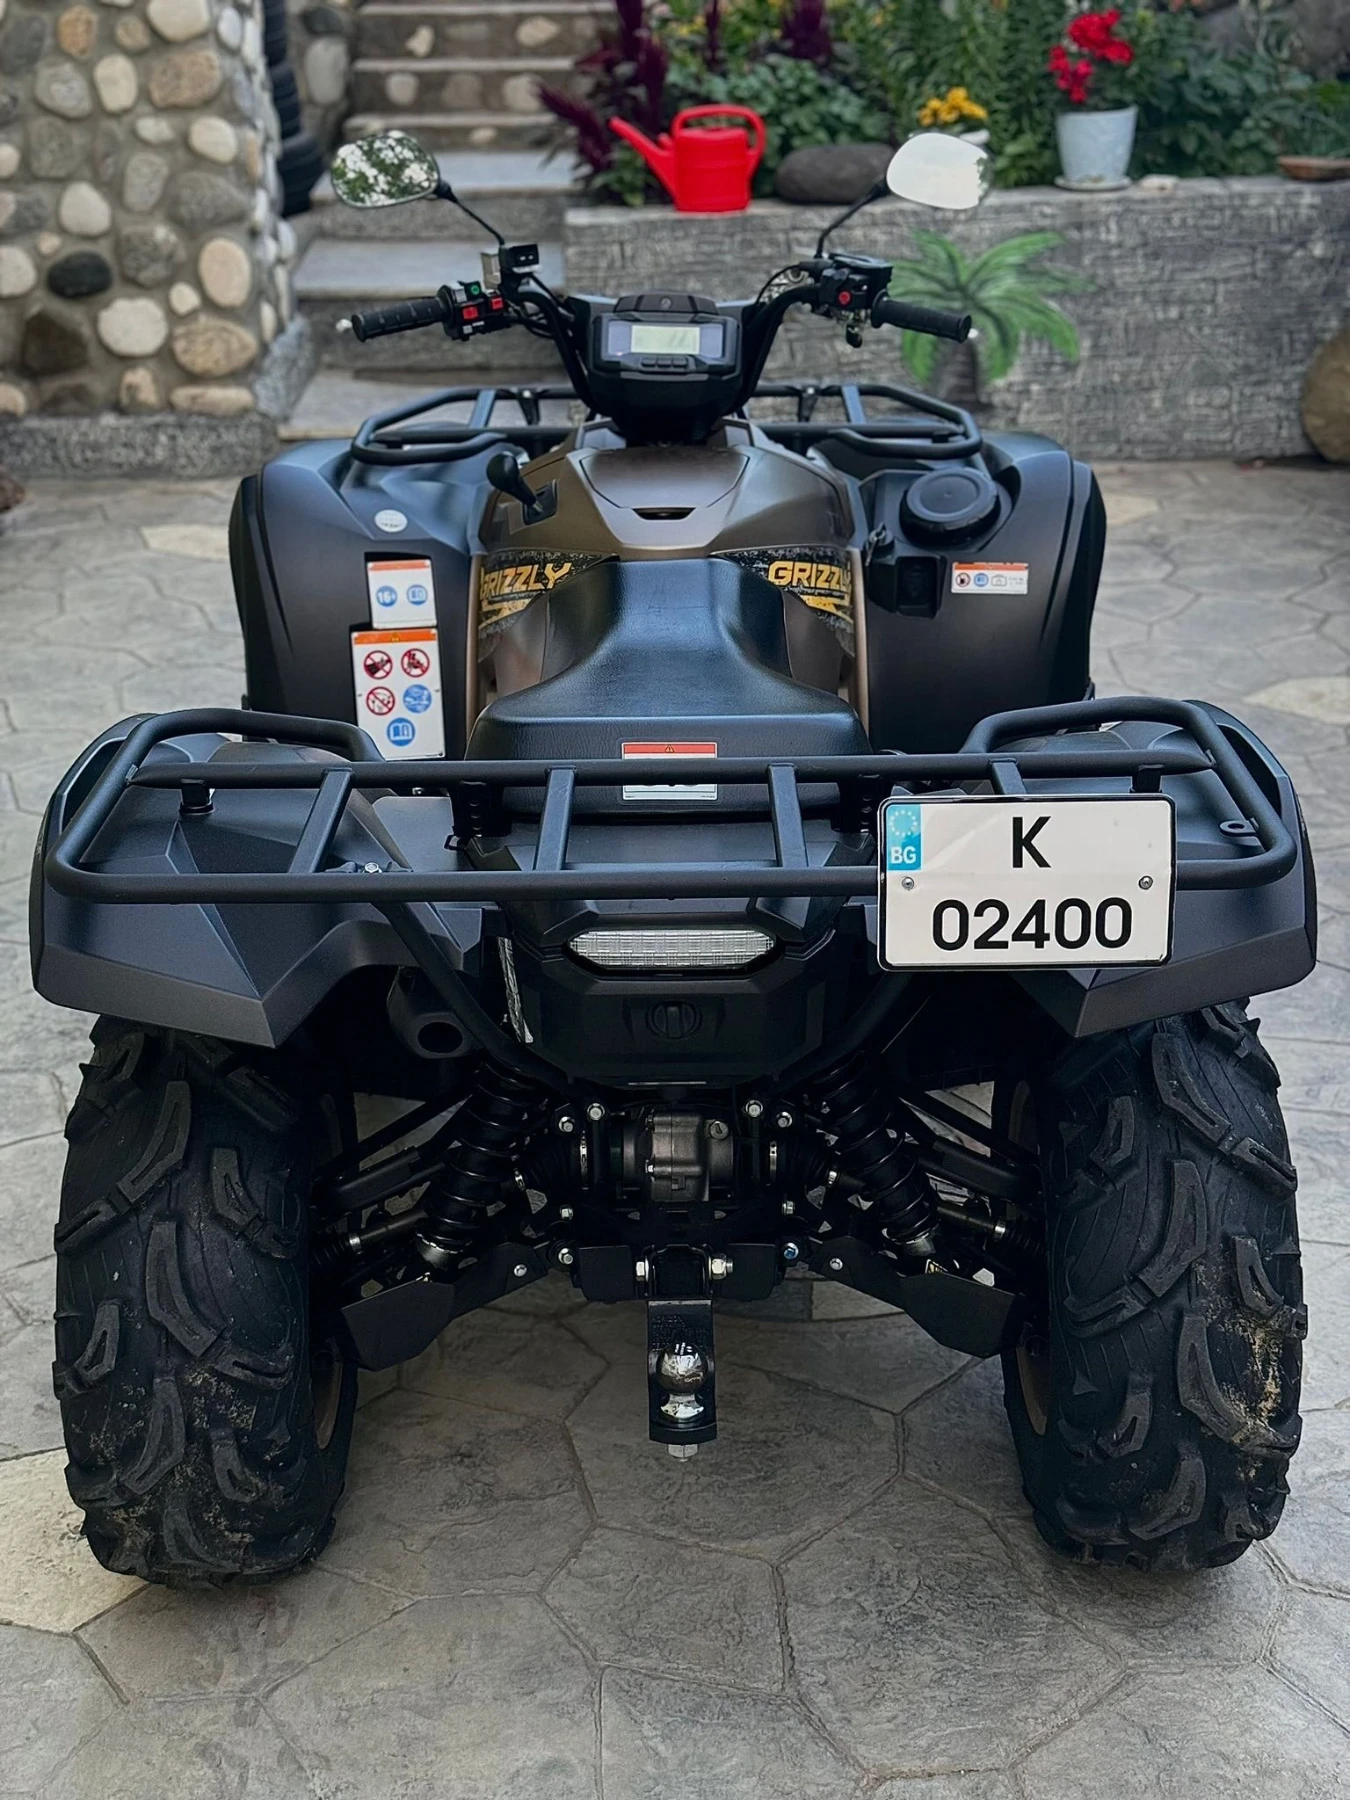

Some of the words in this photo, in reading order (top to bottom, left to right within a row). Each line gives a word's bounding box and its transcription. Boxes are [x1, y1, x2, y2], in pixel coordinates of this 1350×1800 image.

[480, 563, 572, 598] GRIZZLY
[891, 846, 917, 864] BG
[1012, 816, 1051, 868] K
[932, 897, 1132, 951] 02400
